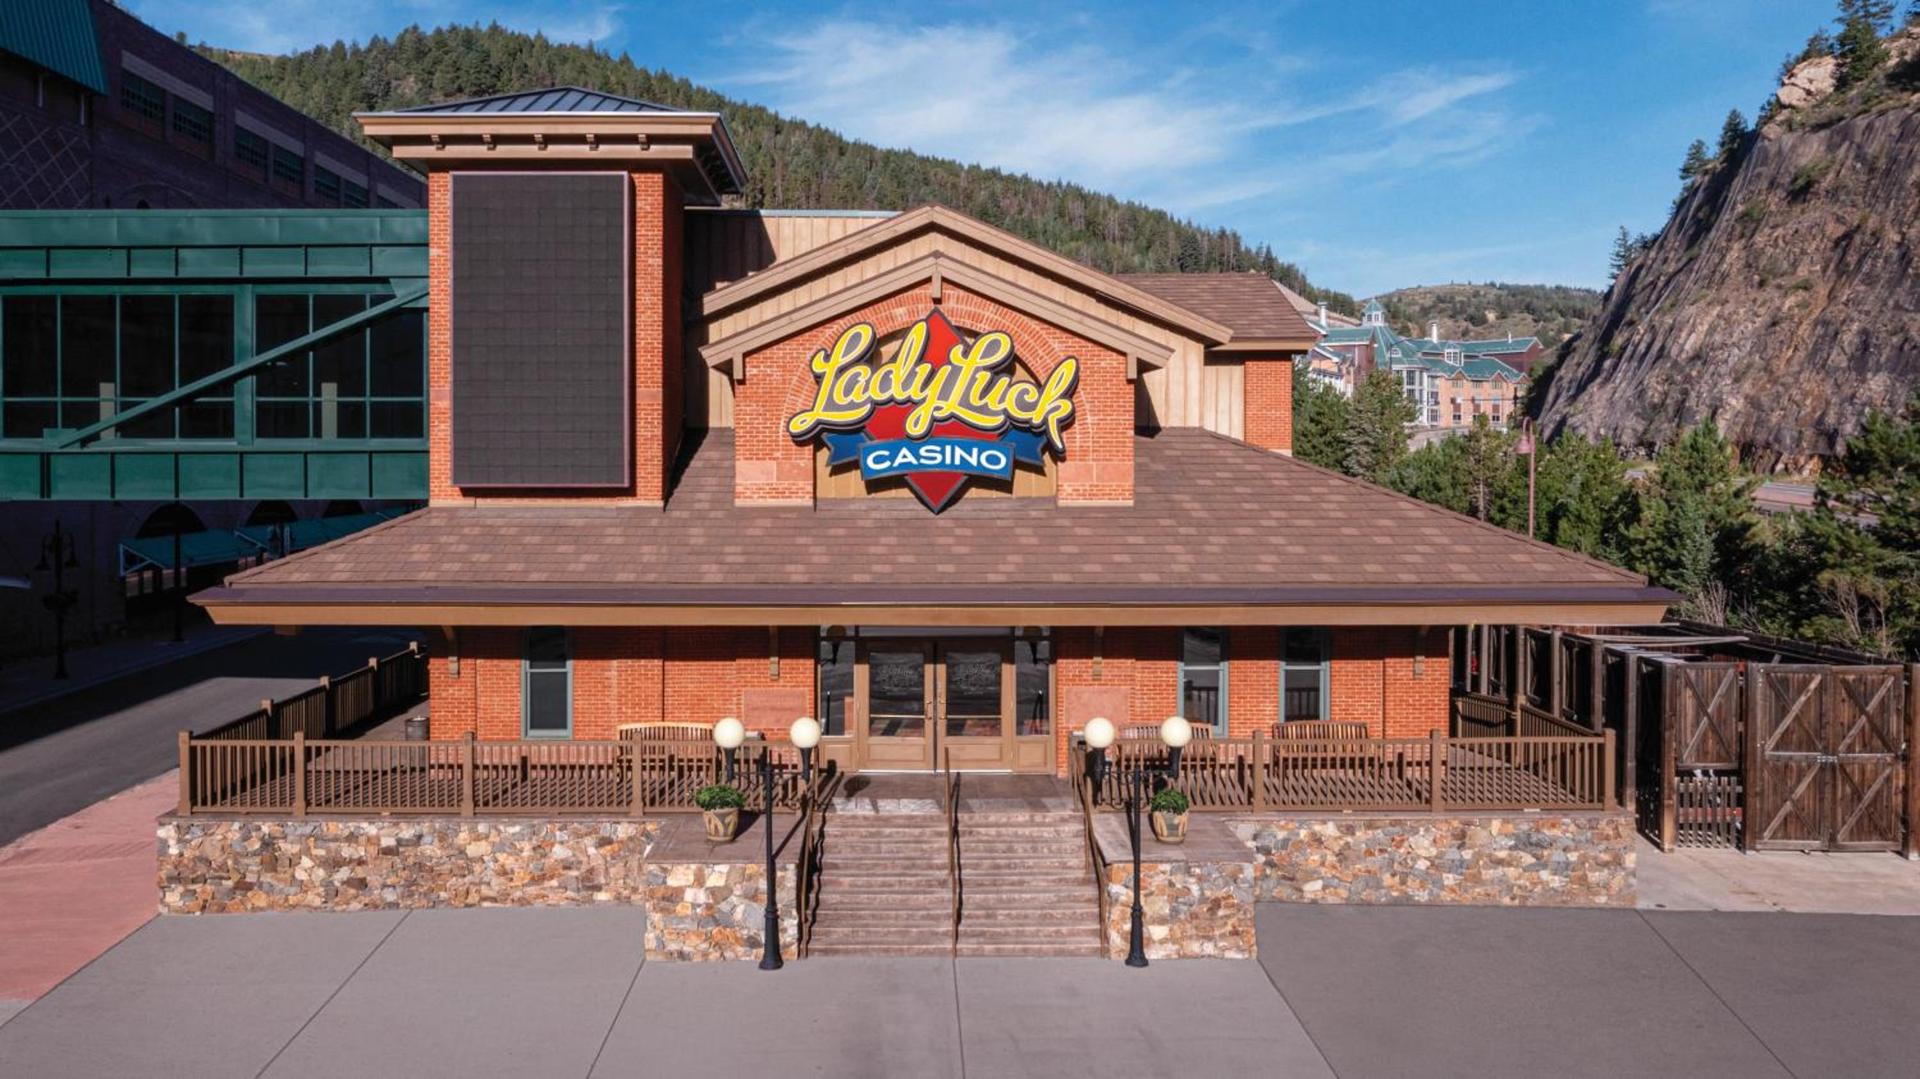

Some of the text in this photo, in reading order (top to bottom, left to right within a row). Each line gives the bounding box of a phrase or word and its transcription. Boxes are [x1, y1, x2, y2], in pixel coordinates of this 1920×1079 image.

[789, 321, 1079, 449] Lady Luck
[866, 445, 1007, 470] CASINO
